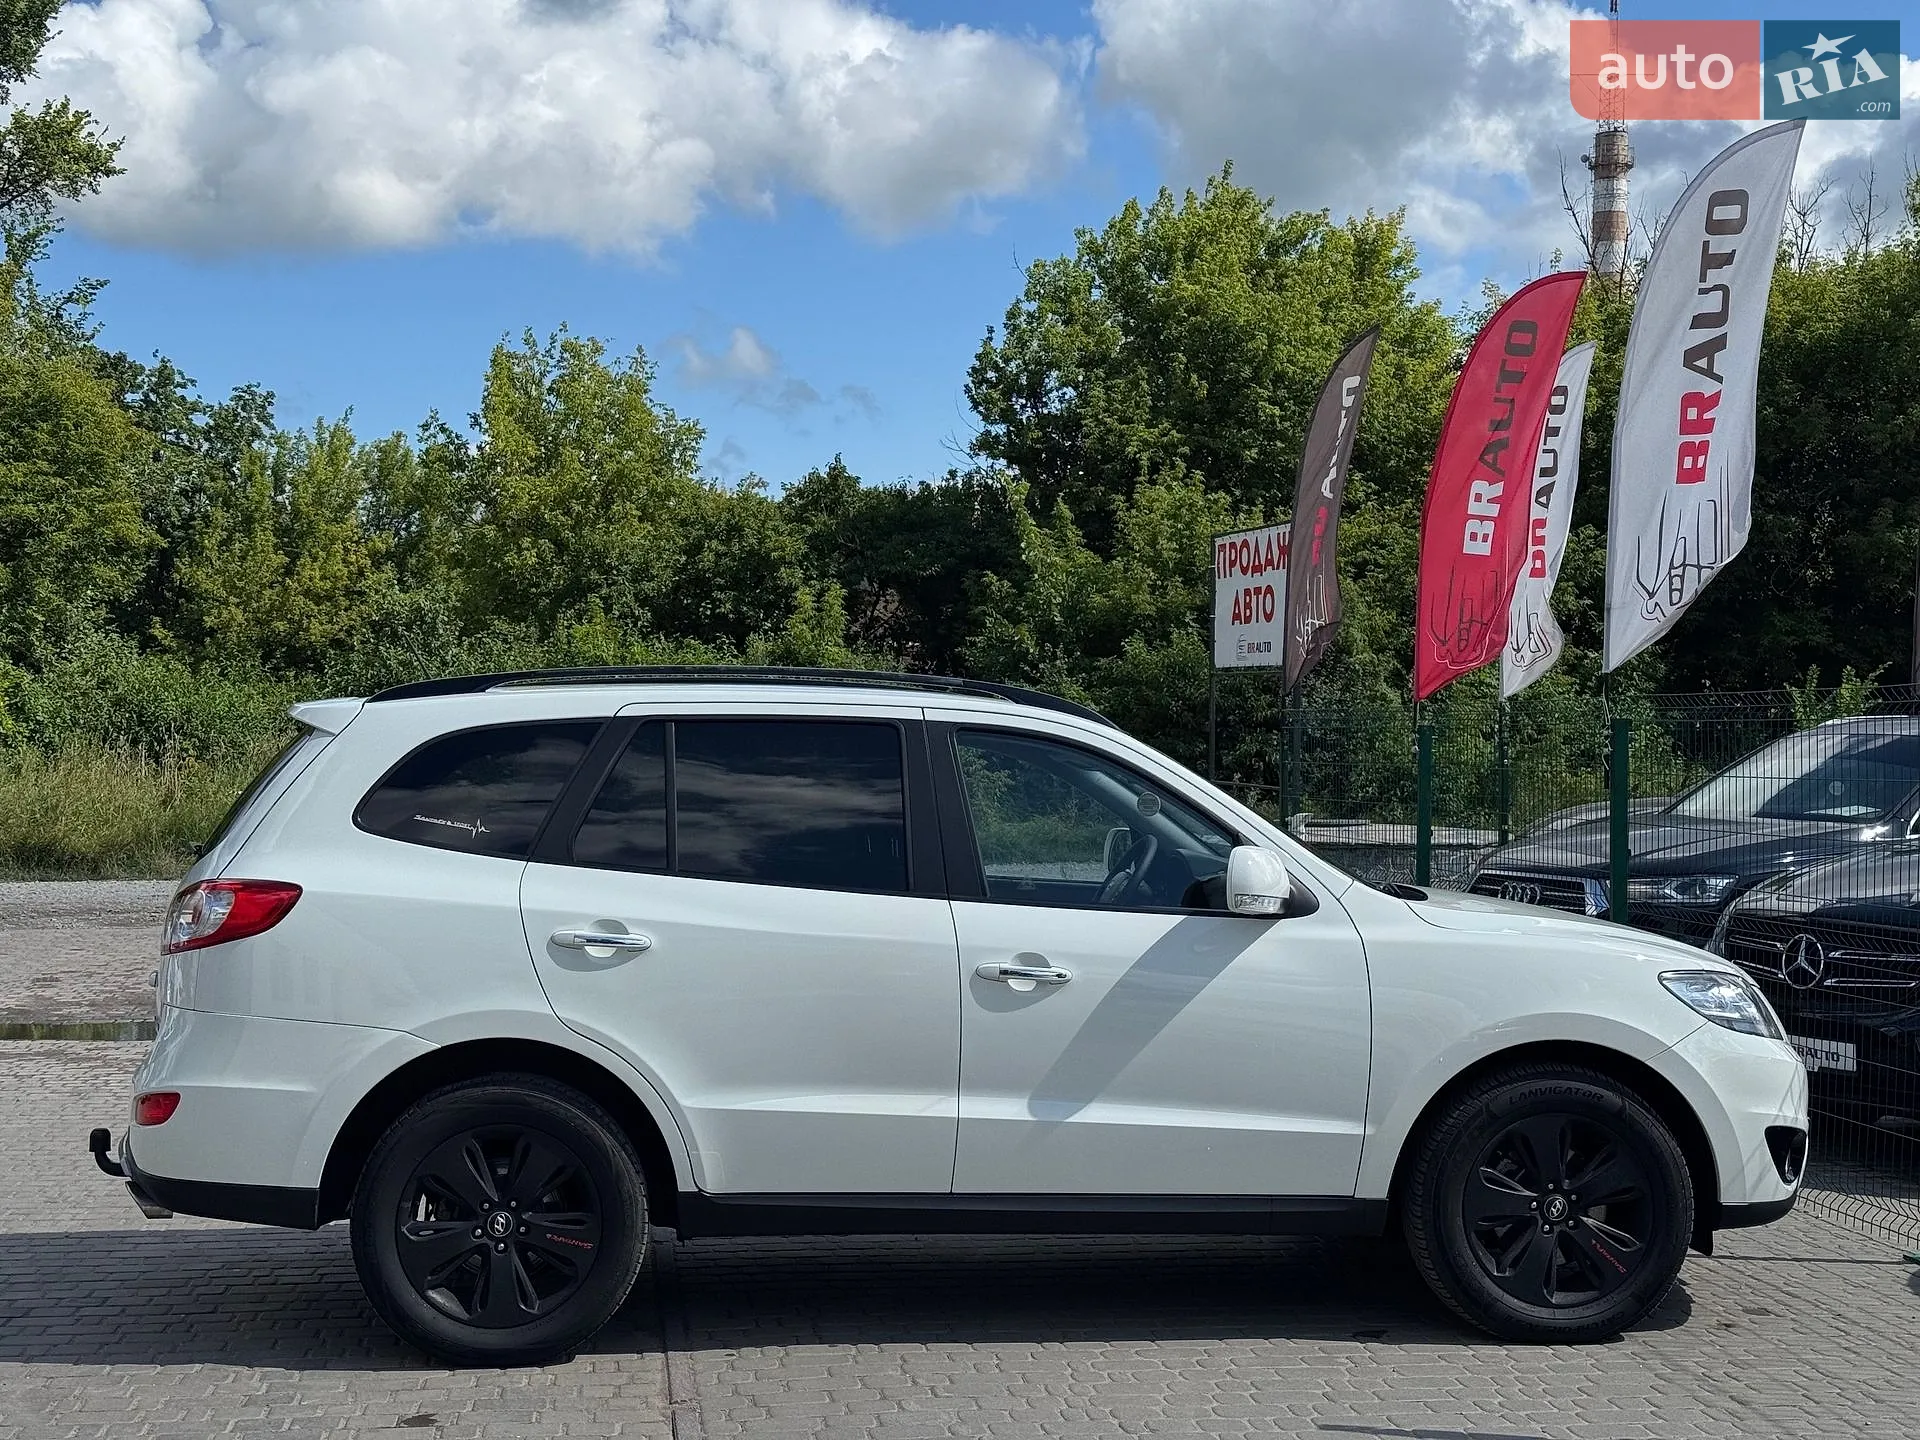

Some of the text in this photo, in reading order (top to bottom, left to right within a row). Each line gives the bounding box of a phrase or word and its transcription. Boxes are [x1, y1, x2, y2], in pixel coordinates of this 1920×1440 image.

[1676, 188, 1751, 485] BRAUTO
[1463, 319, 1539, 557] BRAUTO
[1231, 584, 1276, 626] АВТО
[1509, 1086, 1605, 1105] LANVIGATOR
